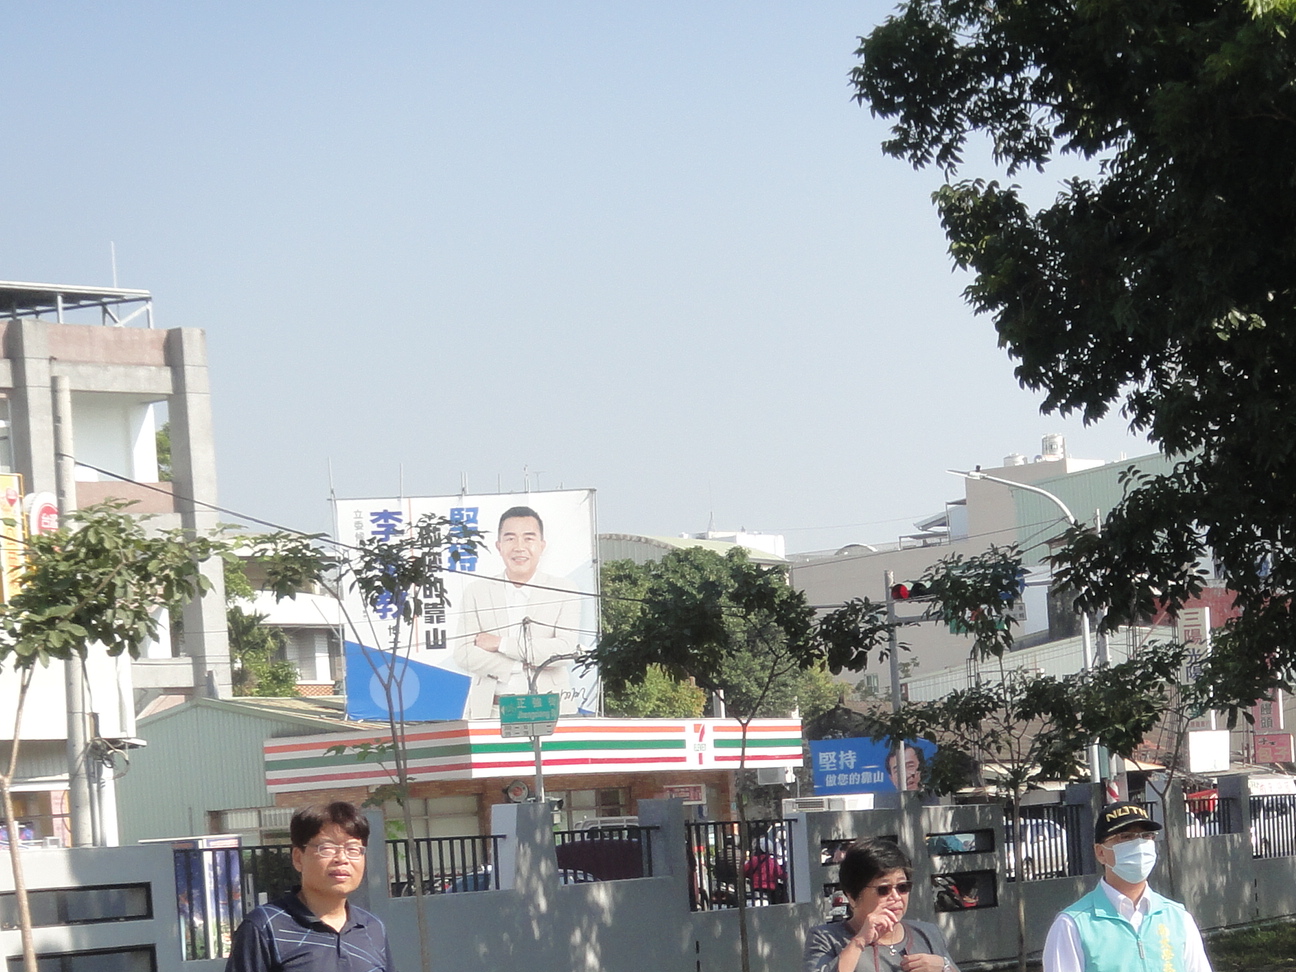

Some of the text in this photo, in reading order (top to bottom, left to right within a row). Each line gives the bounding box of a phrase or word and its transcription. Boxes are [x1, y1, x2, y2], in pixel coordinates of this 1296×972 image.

[447, 507, 479, 572] 堅持
[818, 751, 856, 772] 堅持
[825, 772, 884, 787] 做您的靠山
